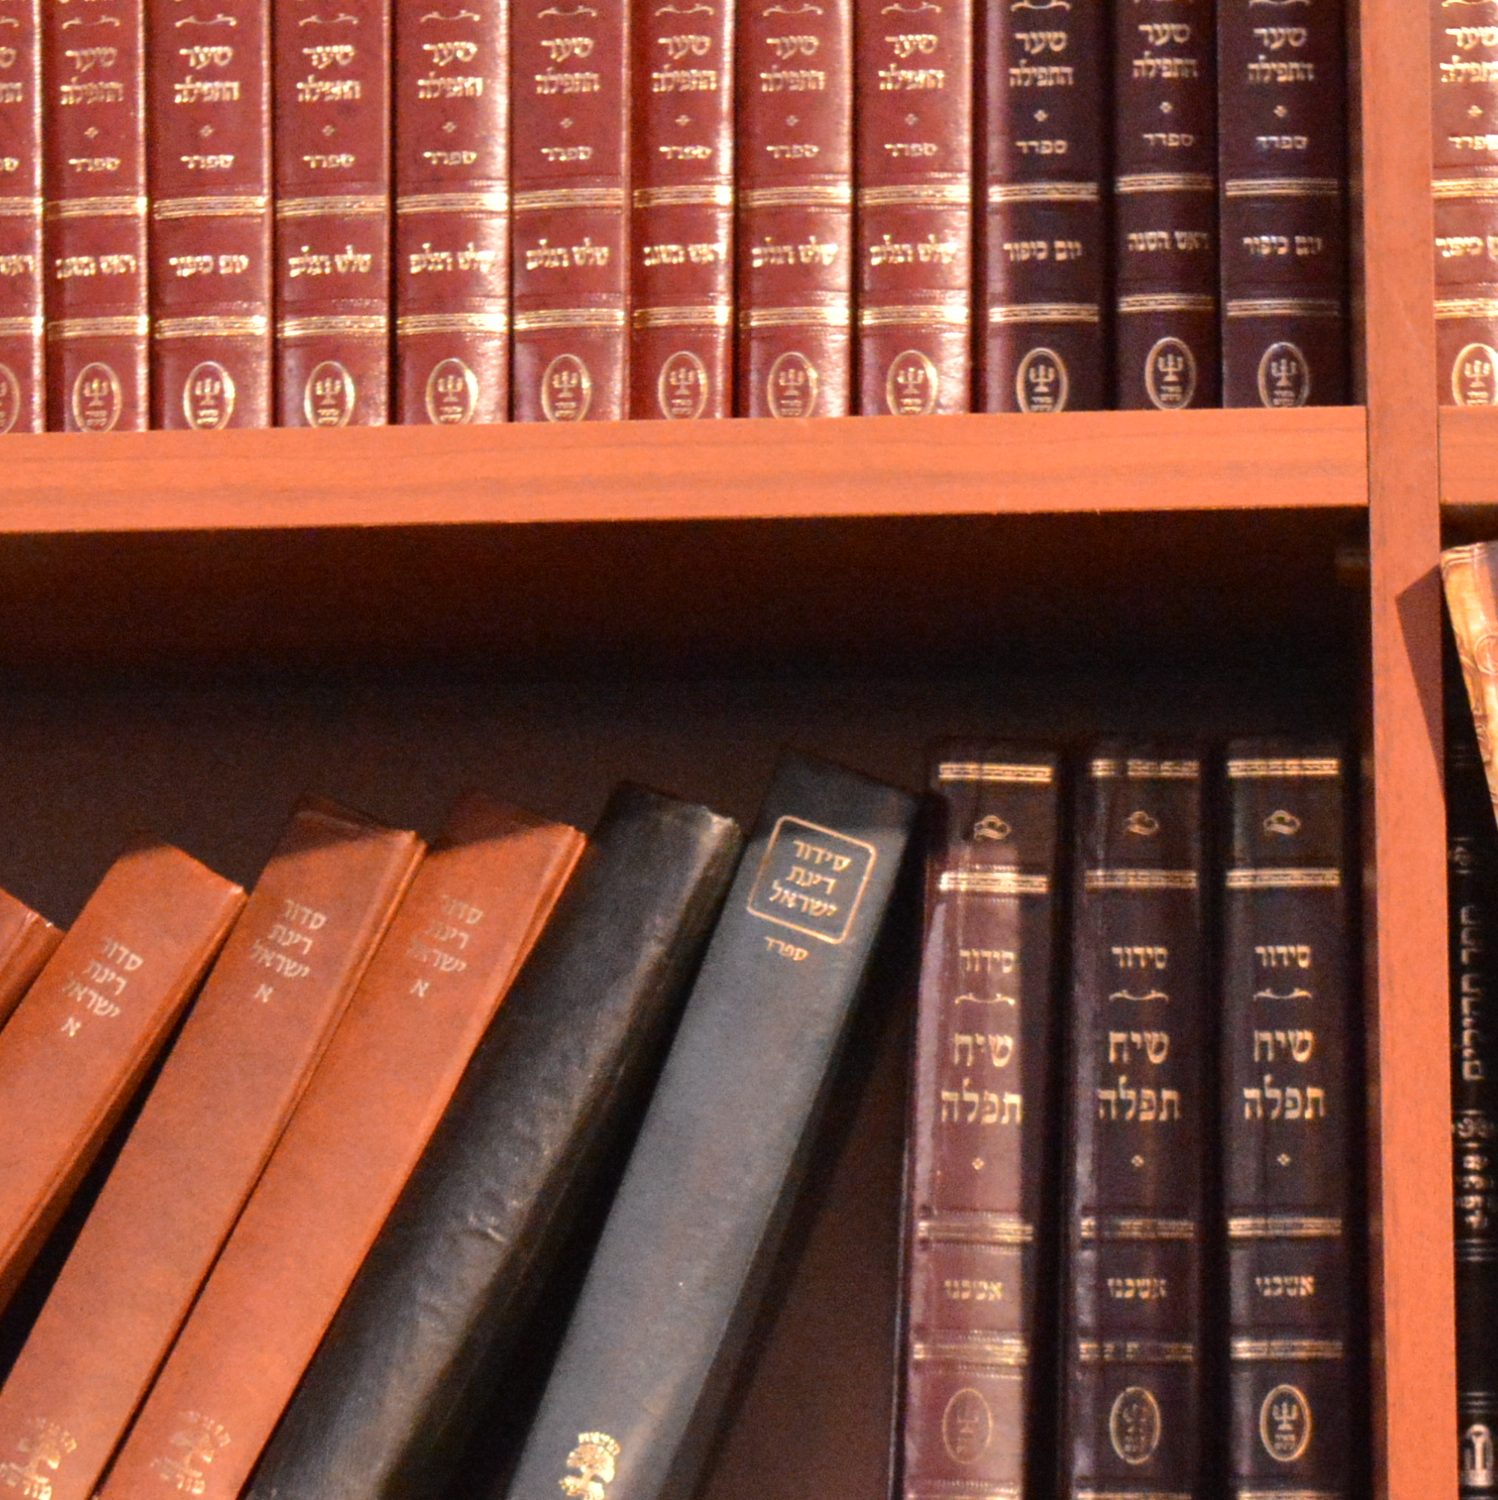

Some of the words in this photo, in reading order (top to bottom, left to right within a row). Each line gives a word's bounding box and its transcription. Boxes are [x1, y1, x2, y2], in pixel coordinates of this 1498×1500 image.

[1015, 30, 1067, 53] שער
[1009, 59, 1074, 87] התפילה
[1016, 139, 1067, 155] ספרד
[1004, 241, 1047, 262] כיפור
[1055, 241, 1082, 260] יום
[793, 840, 851, 872] סידור
[787, 862, 835, 894] רינת
[283, 898, 327, 930] סדור
[770, 880, 838, 917] ישראל
[101, 939, 143, 971] סדור
[267, 924, 314, 954] רינת
[765, 935, 808, 961] ספרד
[250, 938, 310, 980] ישראל
[1111, 945, 1168, 970] סידור
[1254, 944, 1312, 969] סידור
[84, 960, 126, 995] רינת
[253, 983, 273, 1003] א
[64, 977, 121, 1018] ישראל
[62, 1017, 81, 1037] א
[1108, 1030, 1170, 1067] שיח
[1252, 1028, 1314, 1065] שיח
[1099, 1075, 1181, 1124] תפלה
[1243, 1075, 1325, 1123] תפלה
